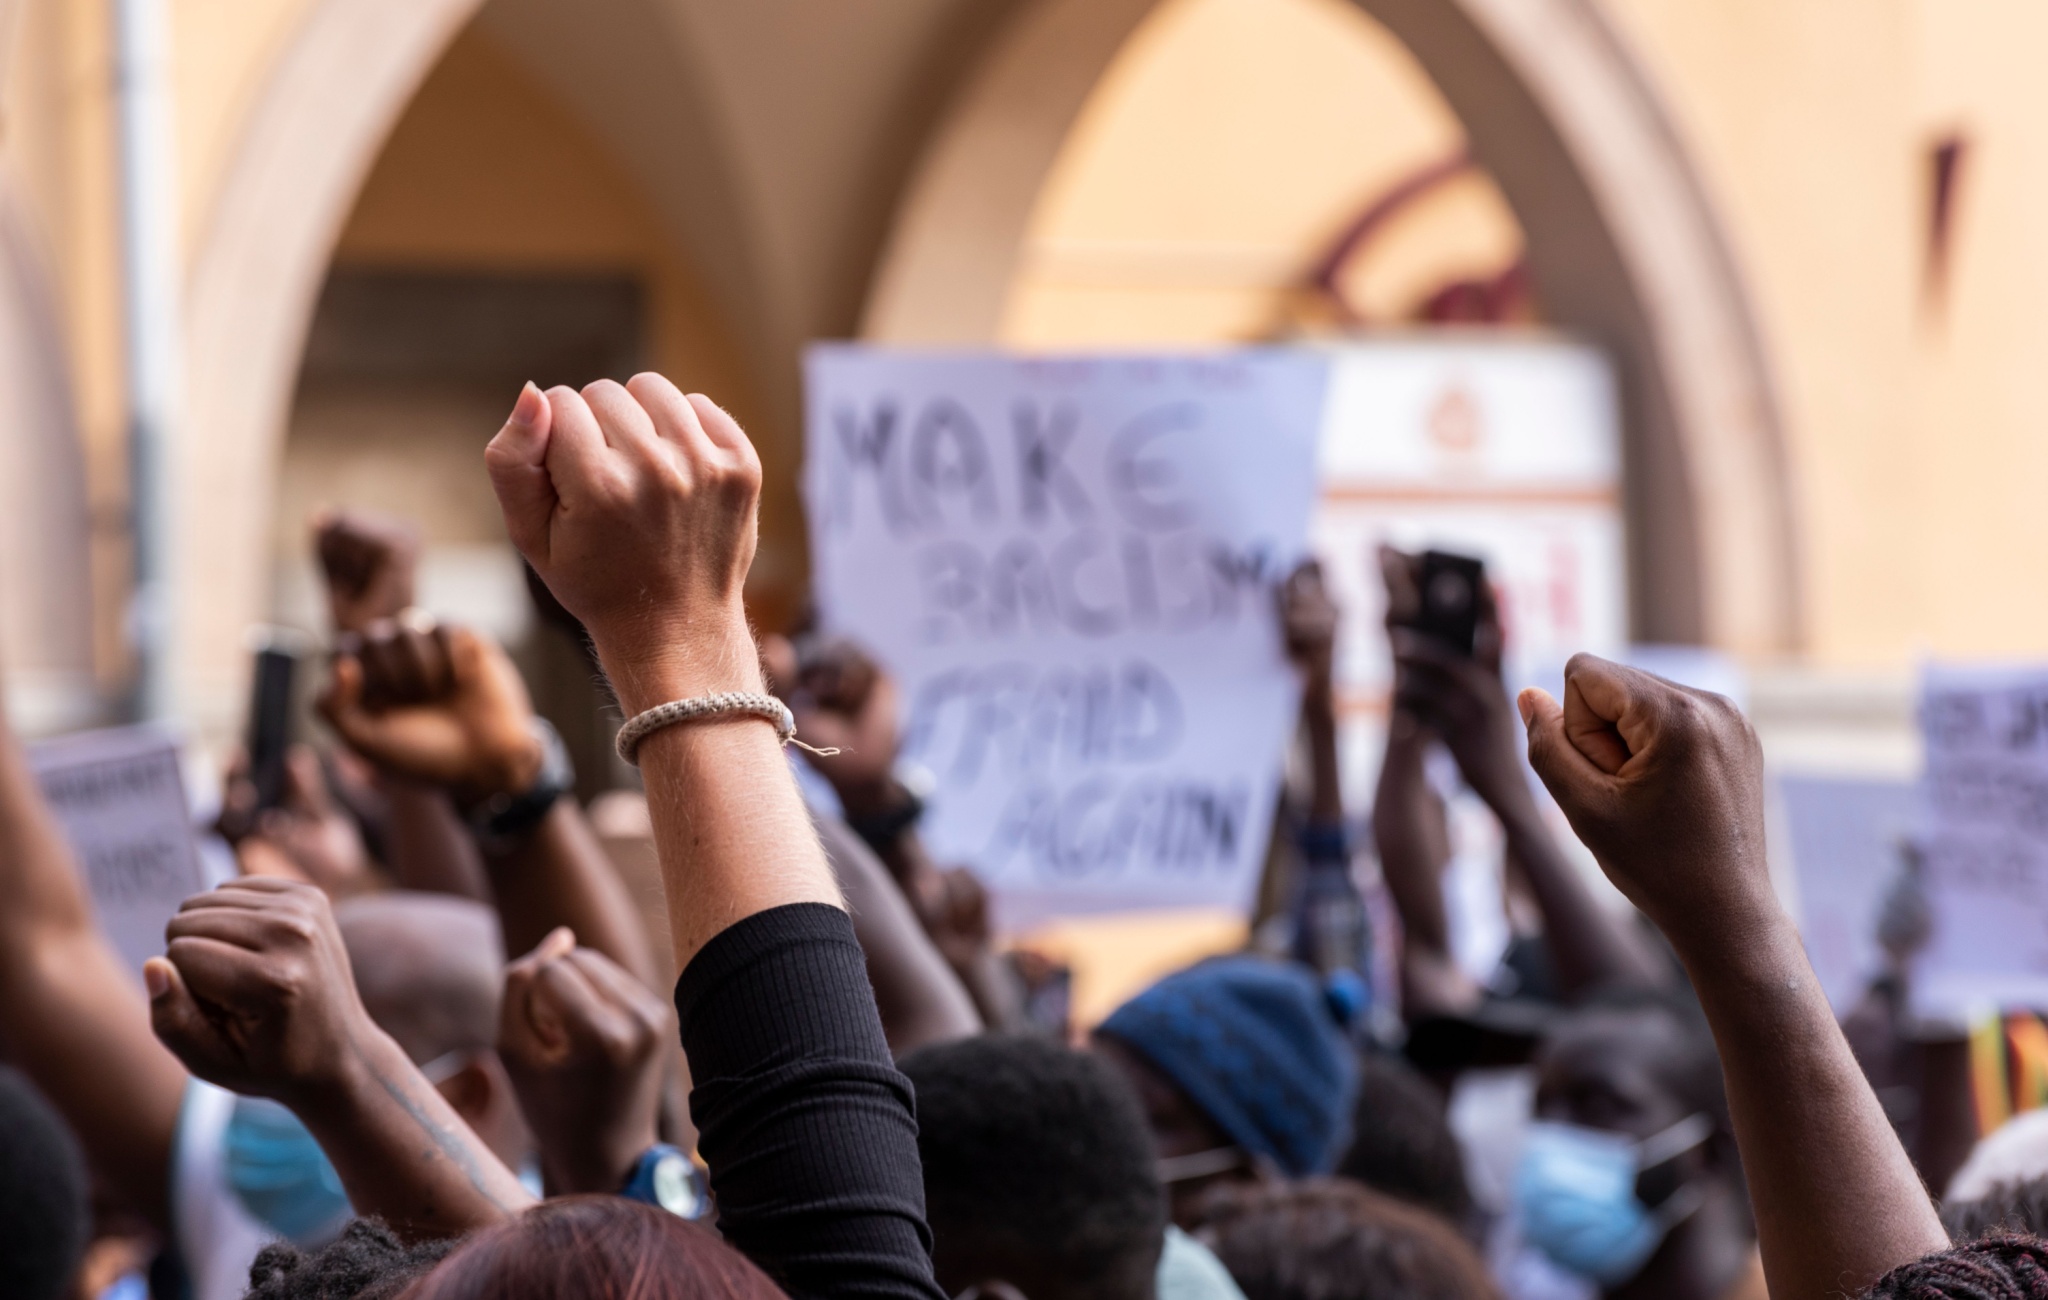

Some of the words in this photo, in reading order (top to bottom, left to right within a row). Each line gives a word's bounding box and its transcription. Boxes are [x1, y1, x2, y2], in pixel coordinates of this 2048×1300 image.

[827, 396, 1208, 540] MAKE
[903, 658, 1187, 788] FRAID
[992, 772, 1252, 880] AGAIN
